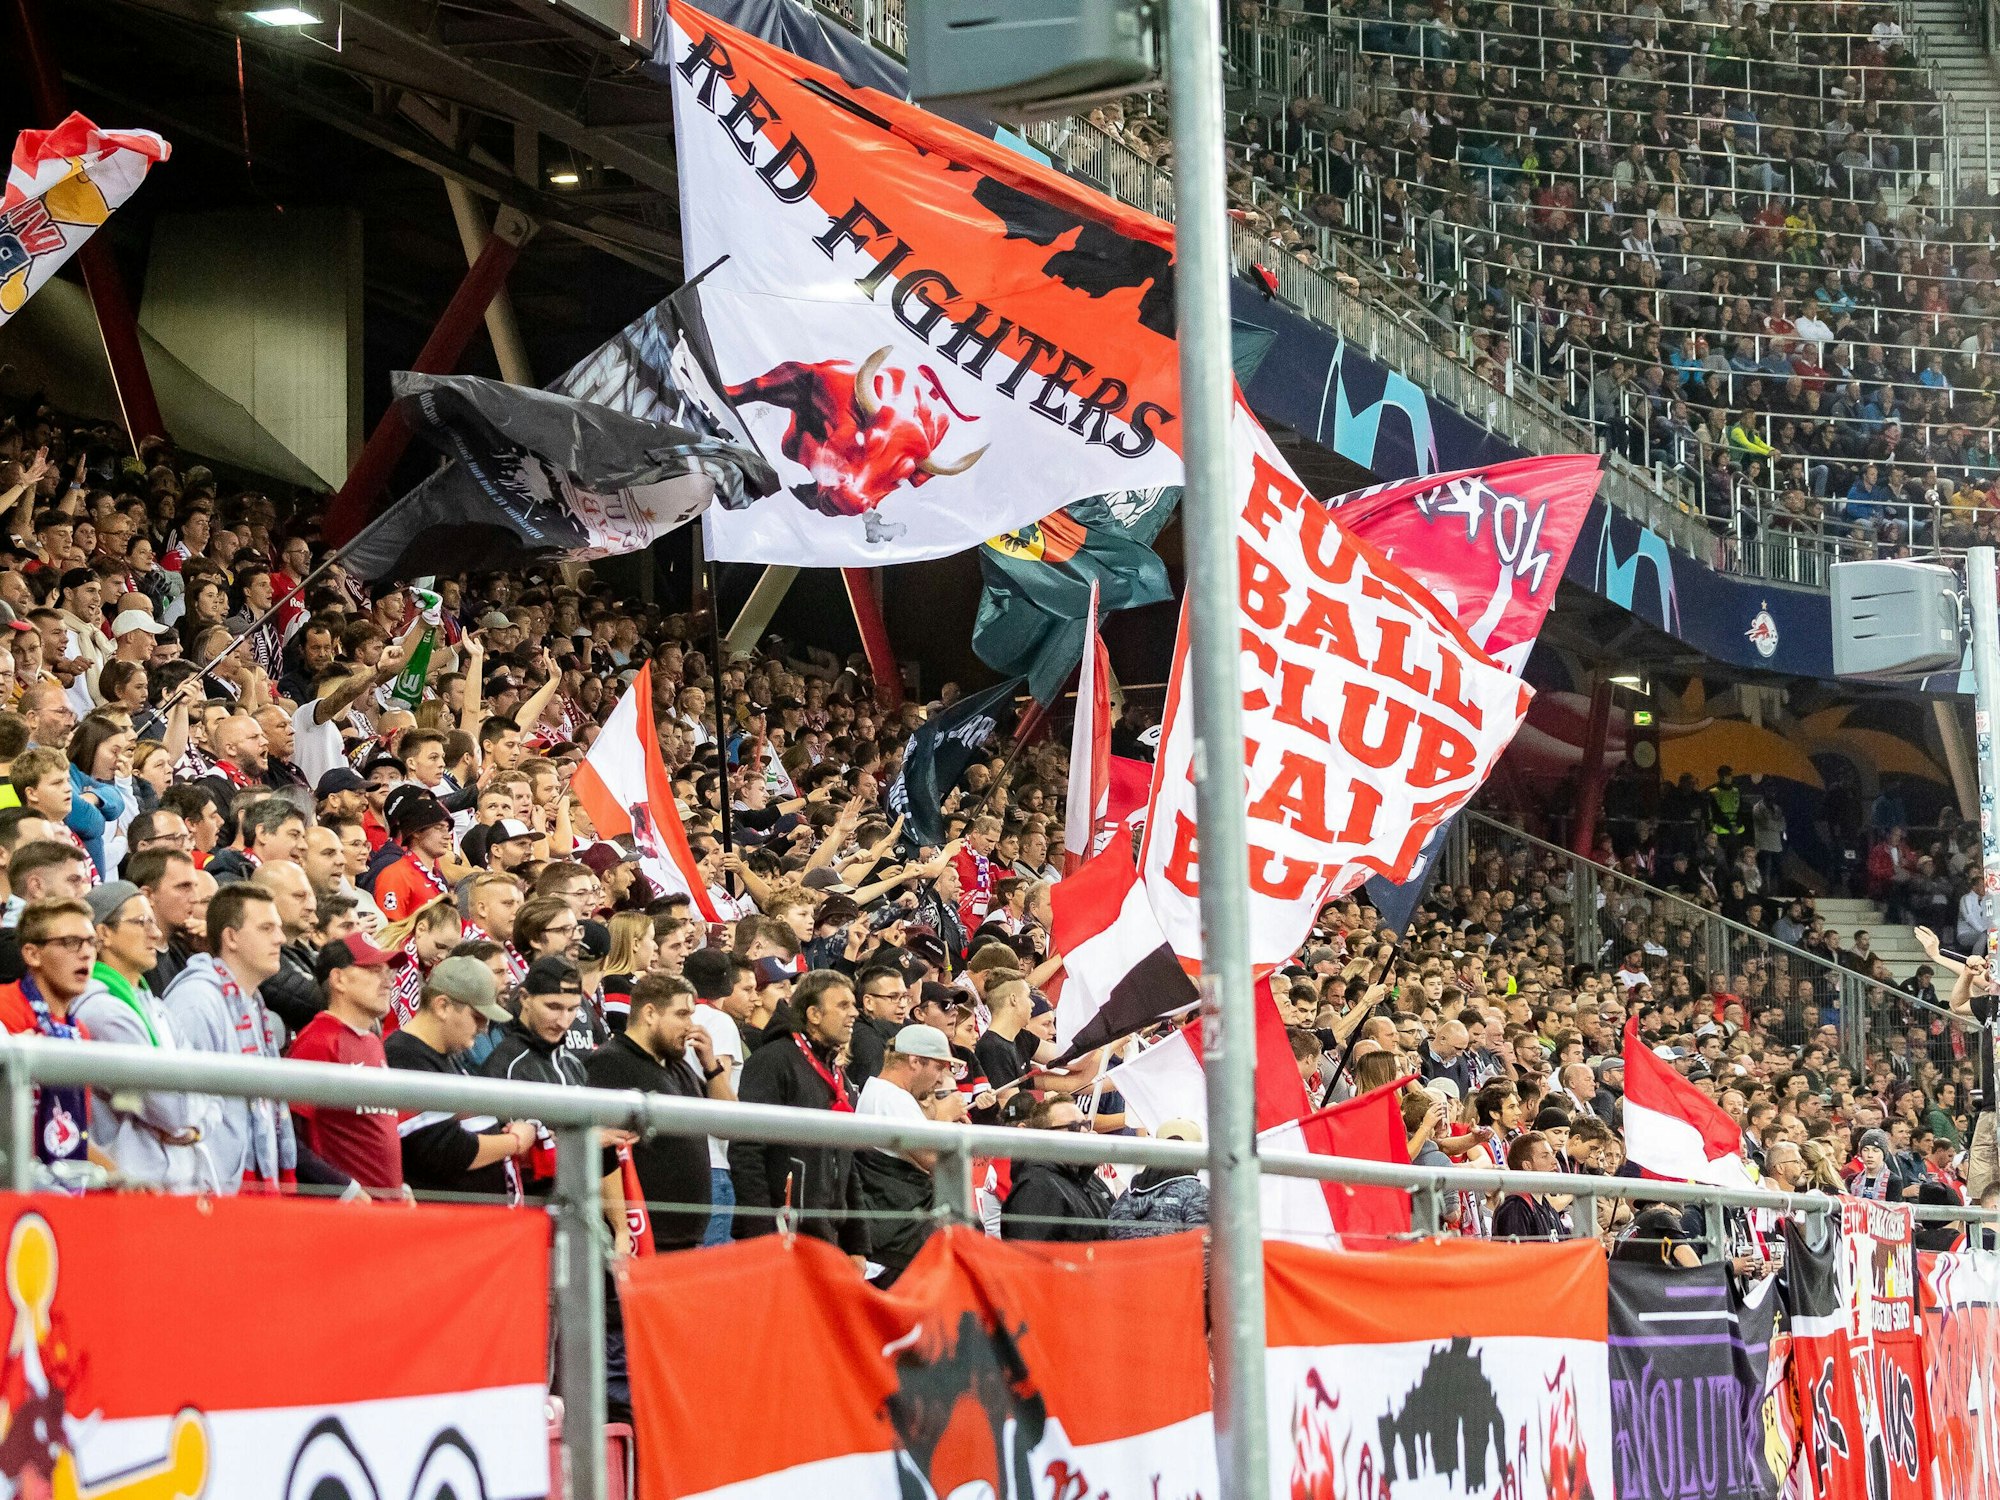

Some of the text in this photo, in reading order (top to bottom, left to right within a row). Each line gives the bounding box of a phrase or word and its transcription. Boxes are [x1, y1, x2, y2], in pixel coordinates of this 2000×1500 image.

[676, 31, 1176, 459] RED FIGHTERS
[1237, 535, 1484, 732] BALL
